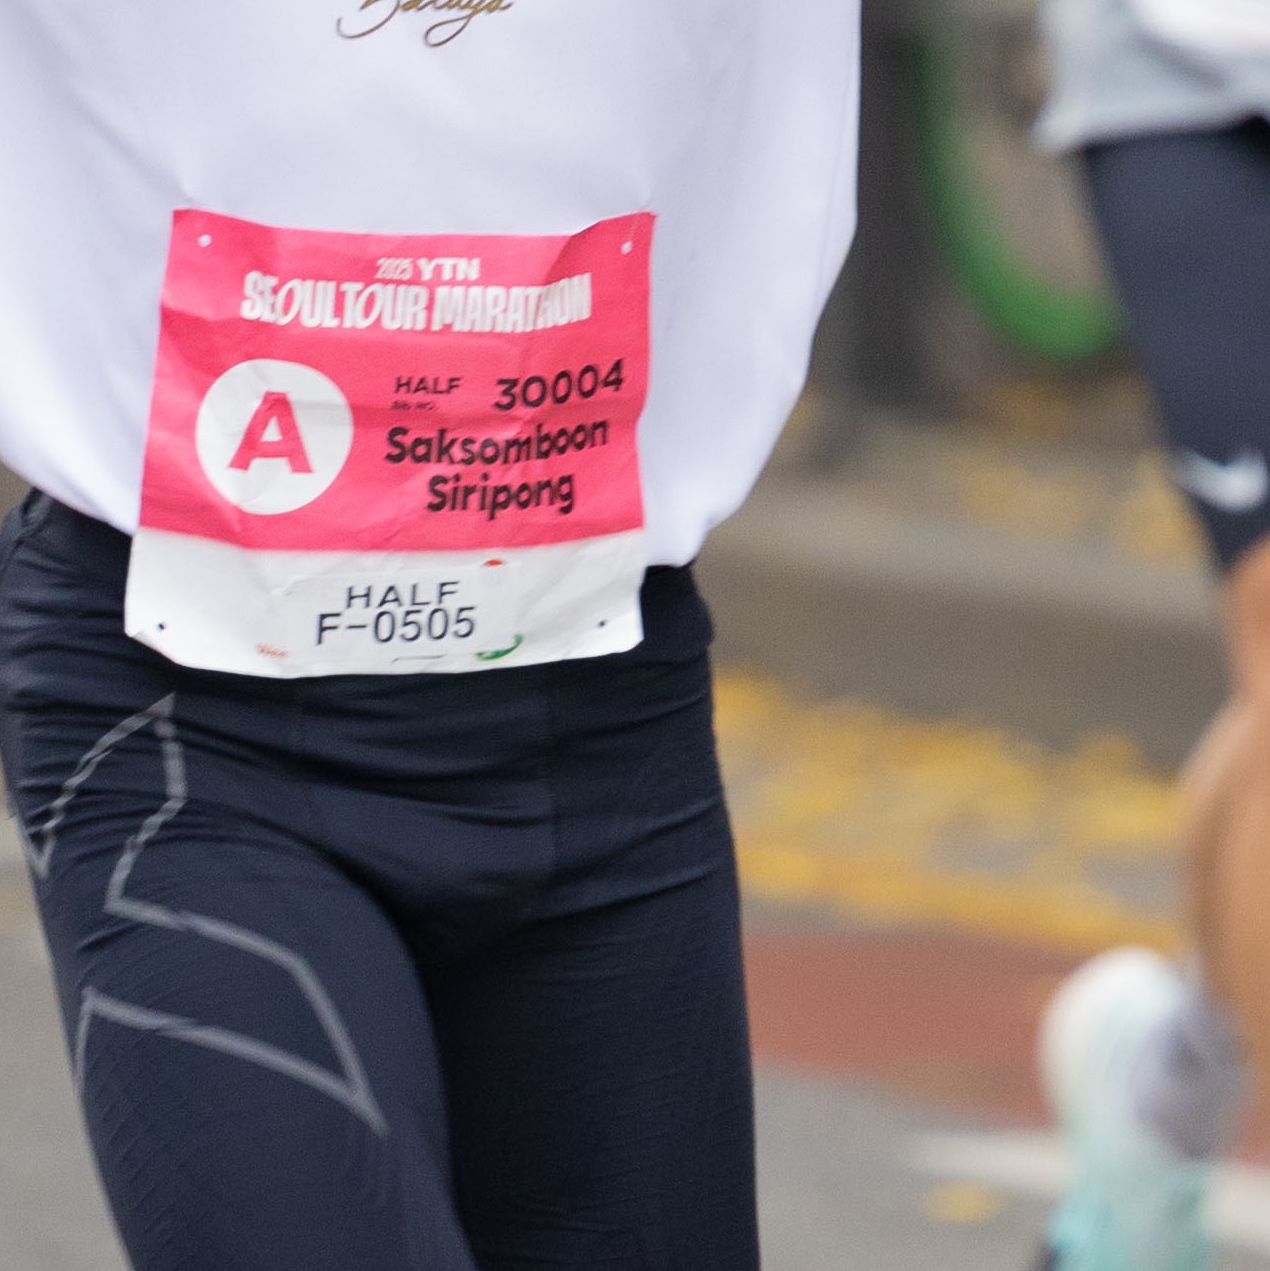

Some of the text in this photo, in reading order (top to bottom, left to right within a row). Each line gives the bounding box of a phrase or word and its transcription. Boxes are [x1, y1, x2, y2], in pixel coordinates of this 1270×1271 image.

[416, 257, 481, 281] YTN
[240, 270, 593, 333] SEOUL TOUR MARATHON
[393, 358, 625, 411] HALF 30004
[227, 390, 315, 475] A
[385, 419, 610, 465] Saksomboon
[426, 472, 575, 521] Siripong
[345, 580, 460, 610] HALF
[314, 606, 477, 646] F-0505
